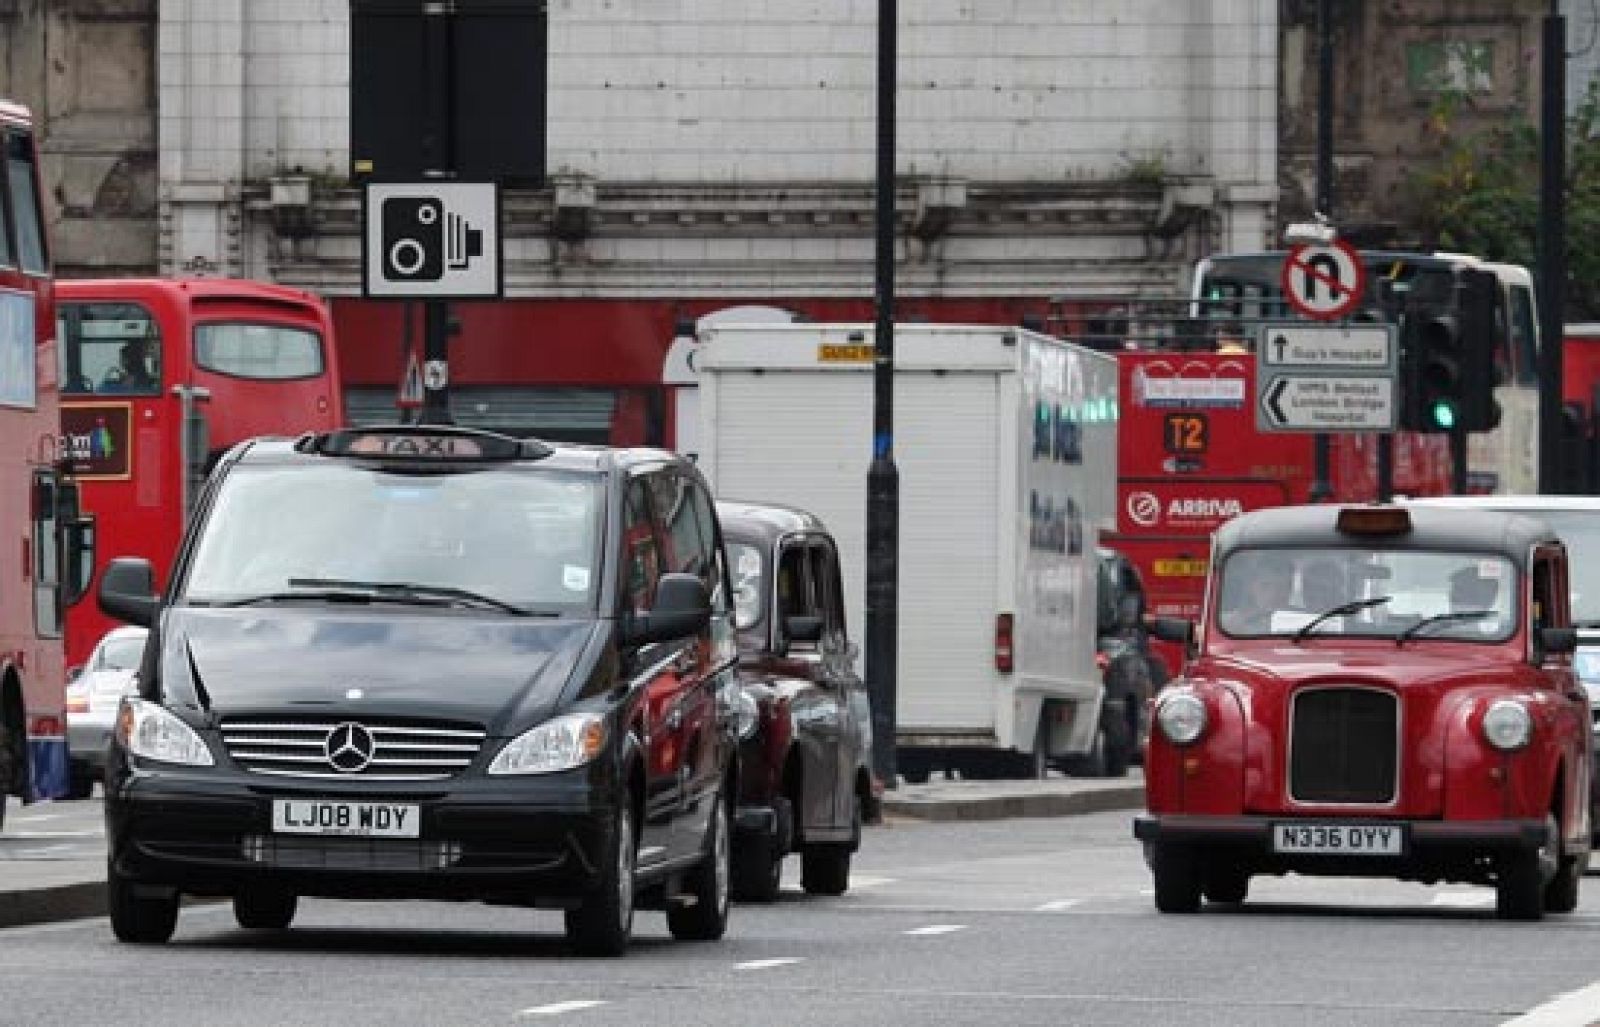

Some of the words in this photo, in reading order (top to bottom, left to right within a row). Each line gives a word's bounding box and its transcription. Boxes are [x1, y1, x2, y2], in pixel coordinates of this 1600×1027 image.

[1168, 418, 1202, 449] T2
[379, 437, 455, 453] TAXI
[1166, 498, 1242, 516] ARRIVA
[285, 802, 350, 827] LJ08
[1282, 828, 1341, 848] N336
